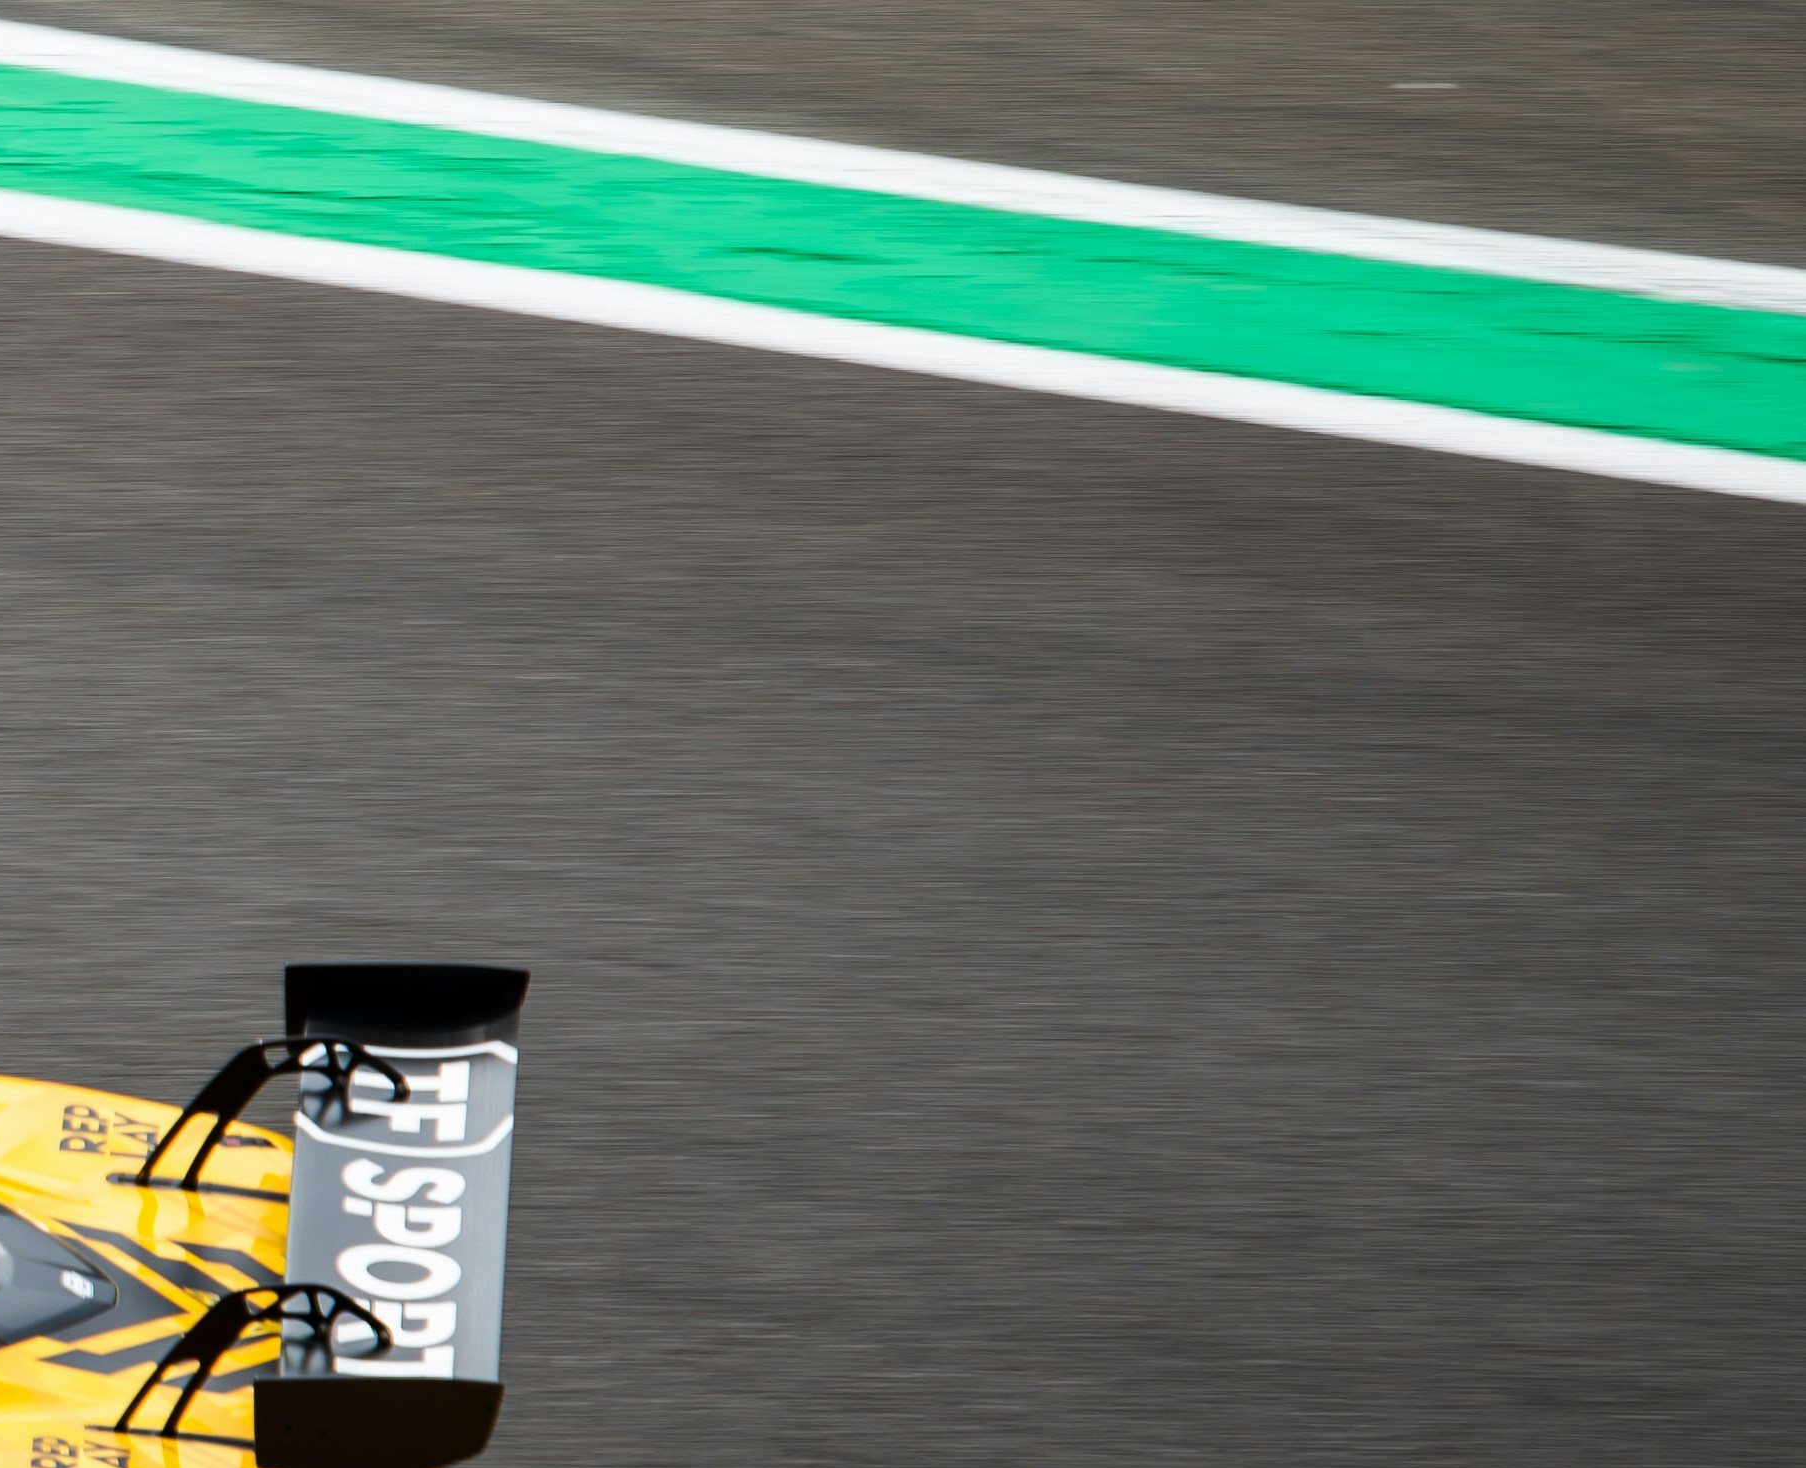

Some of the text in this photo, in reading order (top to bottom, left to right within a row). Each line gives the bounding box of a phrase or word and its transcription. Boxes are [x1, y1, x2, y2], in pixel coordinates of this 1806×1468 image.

[60, 1104, 107, 1155] REP
[335, 1061, 470, 1380] TF SPORT
